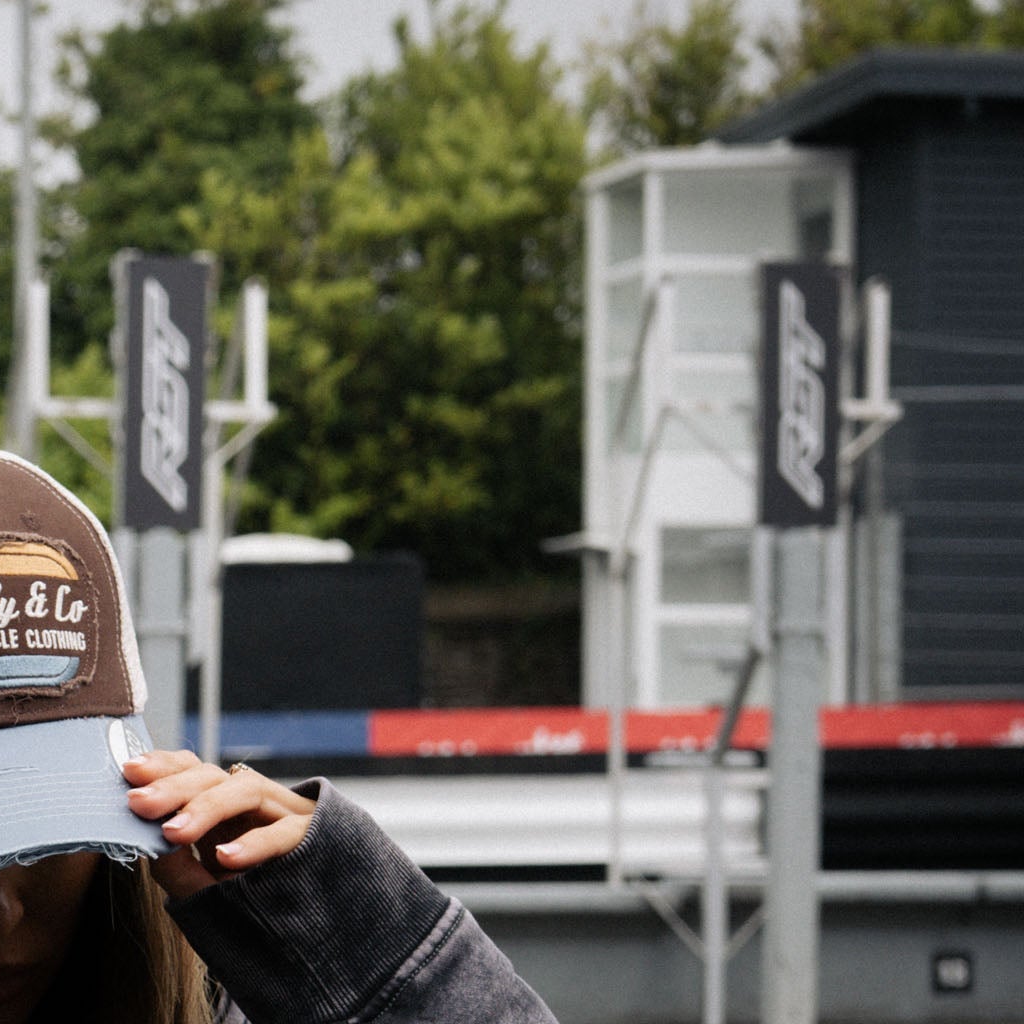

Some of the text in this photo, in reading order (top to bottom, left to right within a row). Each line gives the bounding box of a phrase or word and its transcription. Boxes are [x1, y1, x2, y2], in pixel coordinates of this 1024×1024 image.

[139, 276, 190, 512] RST
[777, 279, 826, 509] RST
[25, 581, 49, 618] &
[54, 585, 89, 624] Co
[25, 628, 87, 651] CLOTHING
